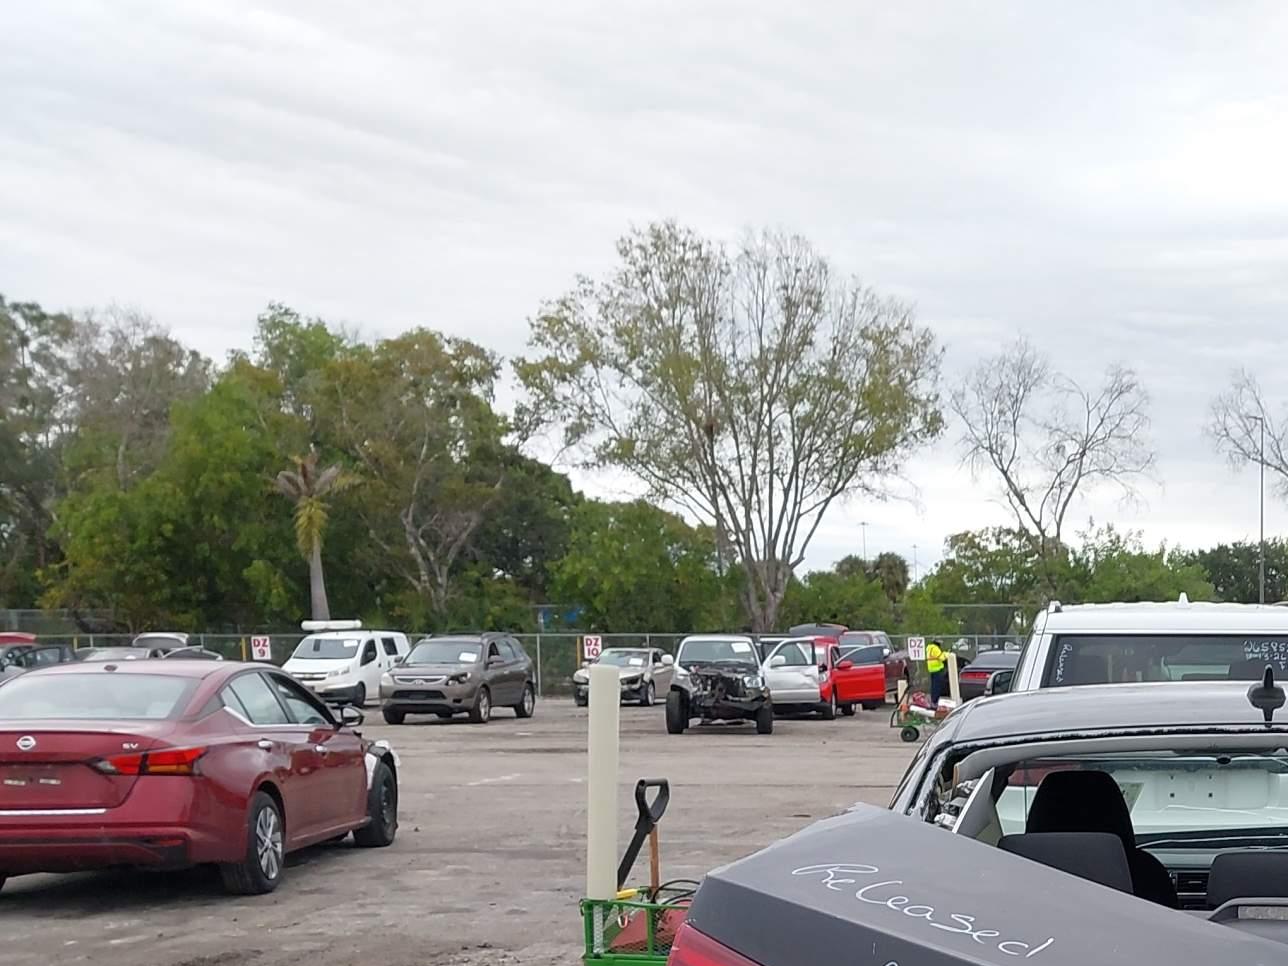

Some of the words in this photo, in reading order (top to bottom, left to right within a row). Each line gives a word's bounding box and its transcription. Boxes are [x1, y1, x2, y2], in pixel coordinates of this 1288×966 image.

[253, 639, 268, 647] DZ
[586, 638, 600, 646] DZ
[910, 639, 923, 648] DZ
[259, 649, 265, 657] 9
[588, 648, 598, 656] 10
[792, 864, 1054, 957] Released
